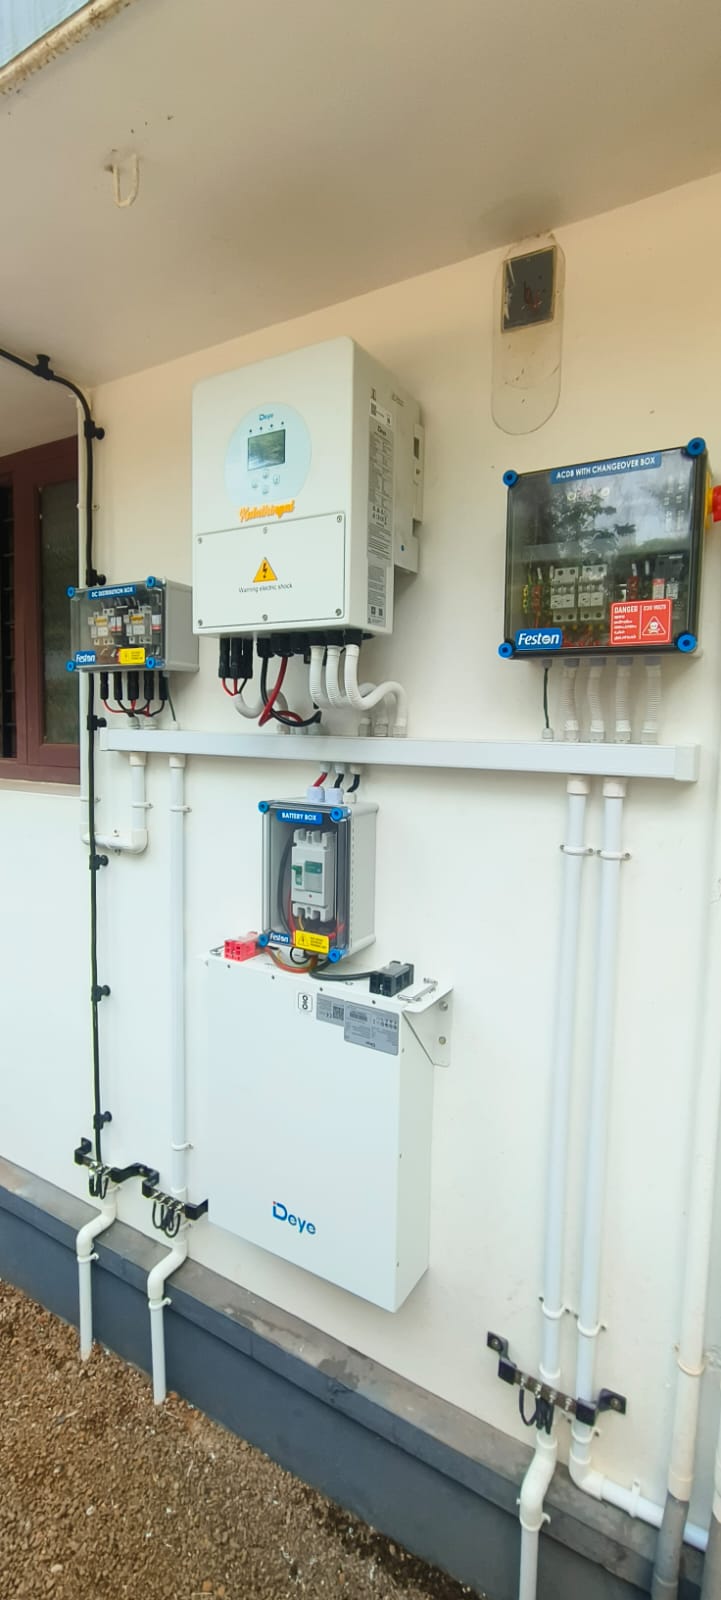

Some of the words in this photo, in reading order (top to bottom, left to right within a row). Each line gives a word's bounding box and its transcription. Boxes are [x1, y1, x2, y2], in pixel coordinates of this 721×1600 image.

[556, 470, 574, 480] ACDB
[575, 467, 591, 477] WITH
[592, 460, 639, 474] CHANGEOVER
[640, 457, 655, 466] BOX
[238, 585, 259, 594] Warning
[614, 605, 638, 614] DANGER
[518, 632, 560, 646] Feston
[76, 653, 96, 664] Feston
[281, 812, 303, 820] BATTERY
[270, 931, 289, 944] Feston
[272, 1200, 316, 1235] Deye
